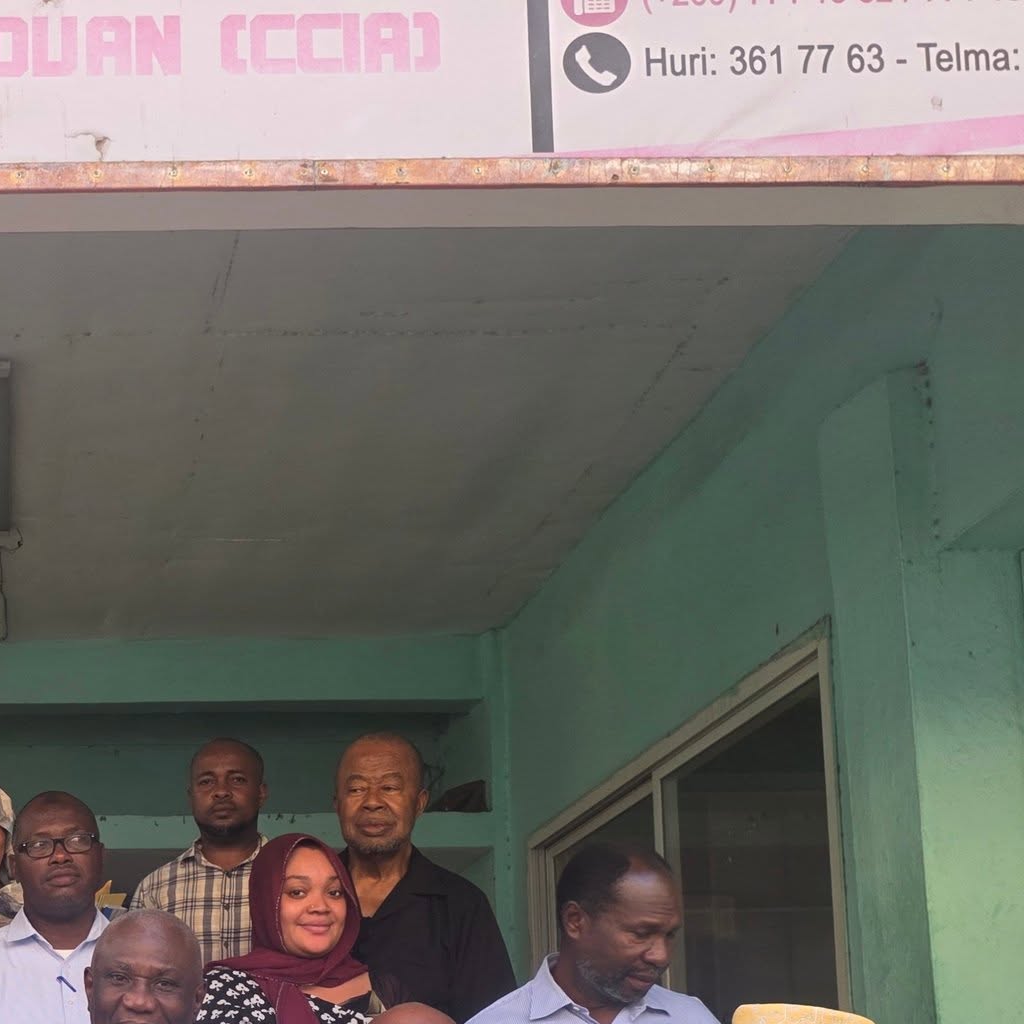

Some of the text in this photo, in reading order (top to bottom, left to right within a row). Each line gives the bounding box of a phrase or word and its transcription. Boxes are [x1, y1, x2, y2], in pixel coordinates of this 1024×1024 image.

[644, 41, 1021, 77] Huri: 361 77 63 - Telma:
